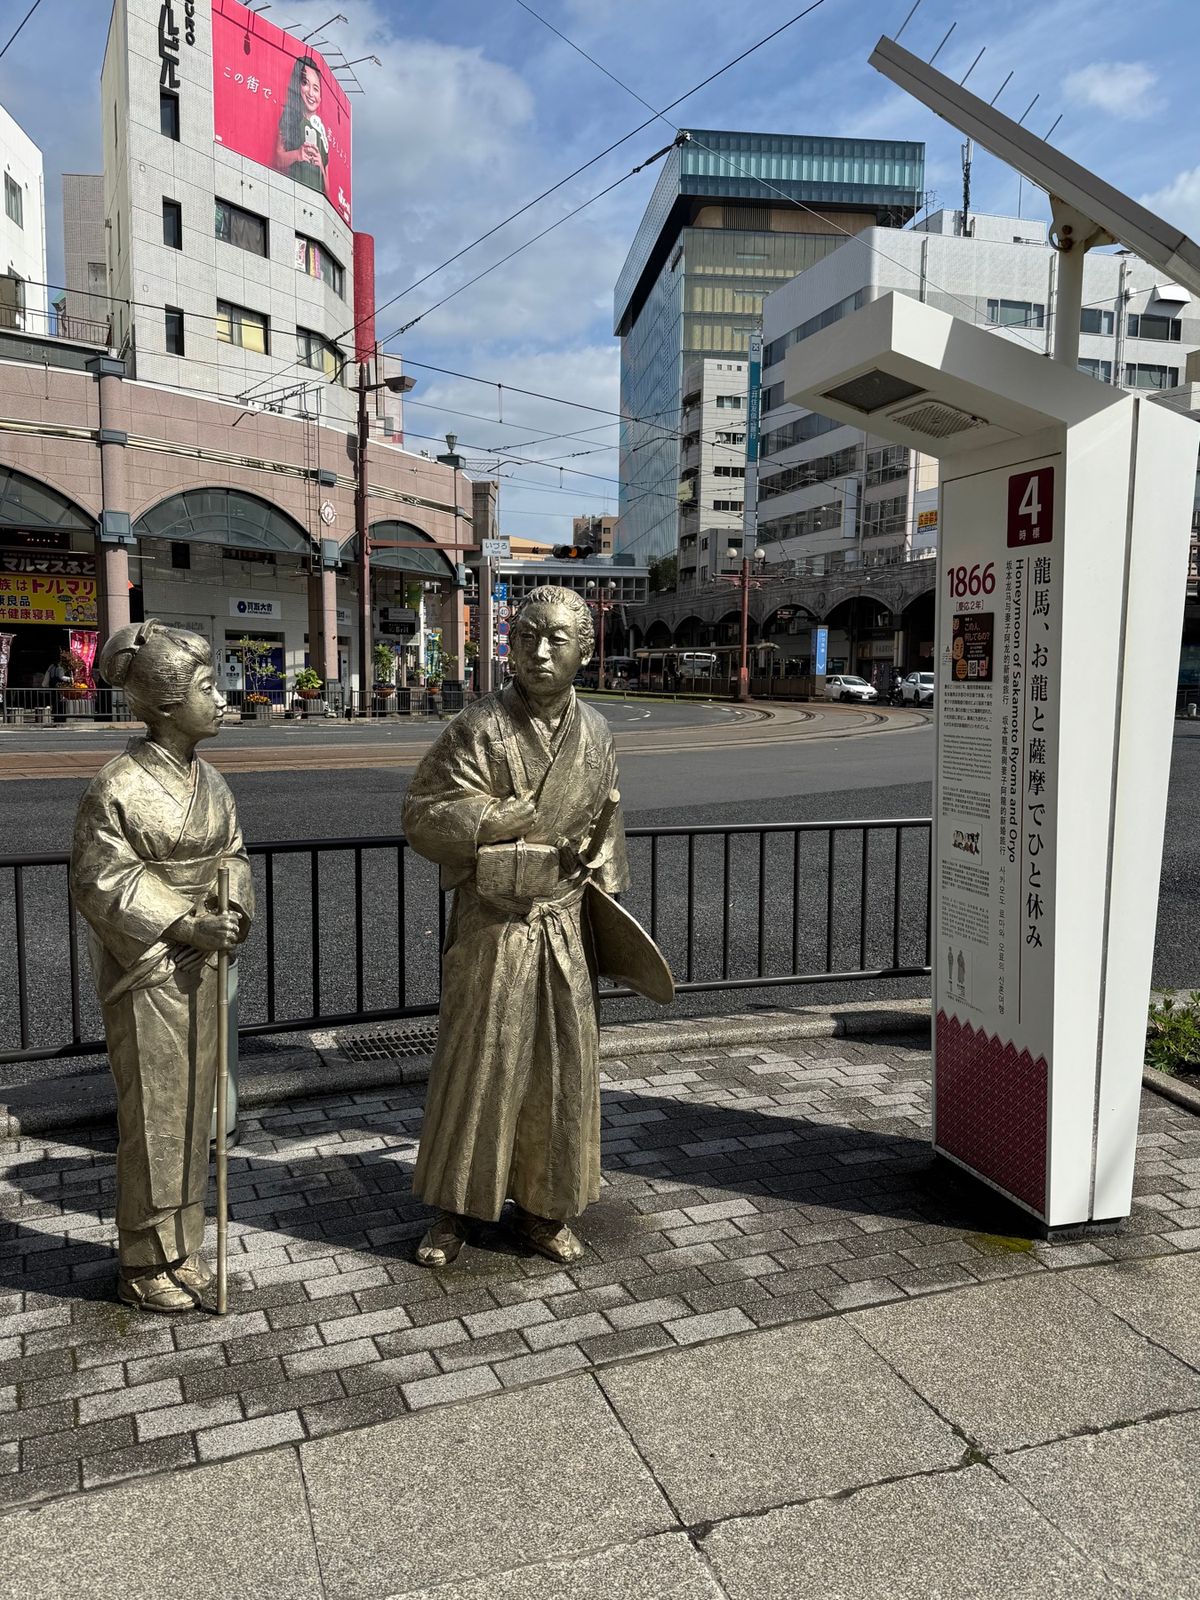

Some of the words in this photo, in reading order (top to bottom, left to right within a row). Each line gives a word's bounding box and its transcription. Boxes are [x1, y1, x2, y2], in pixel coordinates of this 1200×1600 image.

[185, 0, 195, 46] URO
[223, 66, 278, 103] この街で、
[1018, 475, 1042, 525] 4
[485, 542, 508, 550] いづろ
[947, 562, 996, 598] 1866
[499, 608, 508, 616] 40
[1013, 559, 1024, 649] Honeymoon
[1013, 653, 1022, 668] of
[1011, 671, 1021, 743] Sakamoto
[1009, 747, 1019, 795] Ryoma
[1026, 556, 1052, 949] 龍馬、お龍と薩摩でひと休み
[1009, 798, 1018, 825] and
[1007, 828, 1017, 863] Oryo
